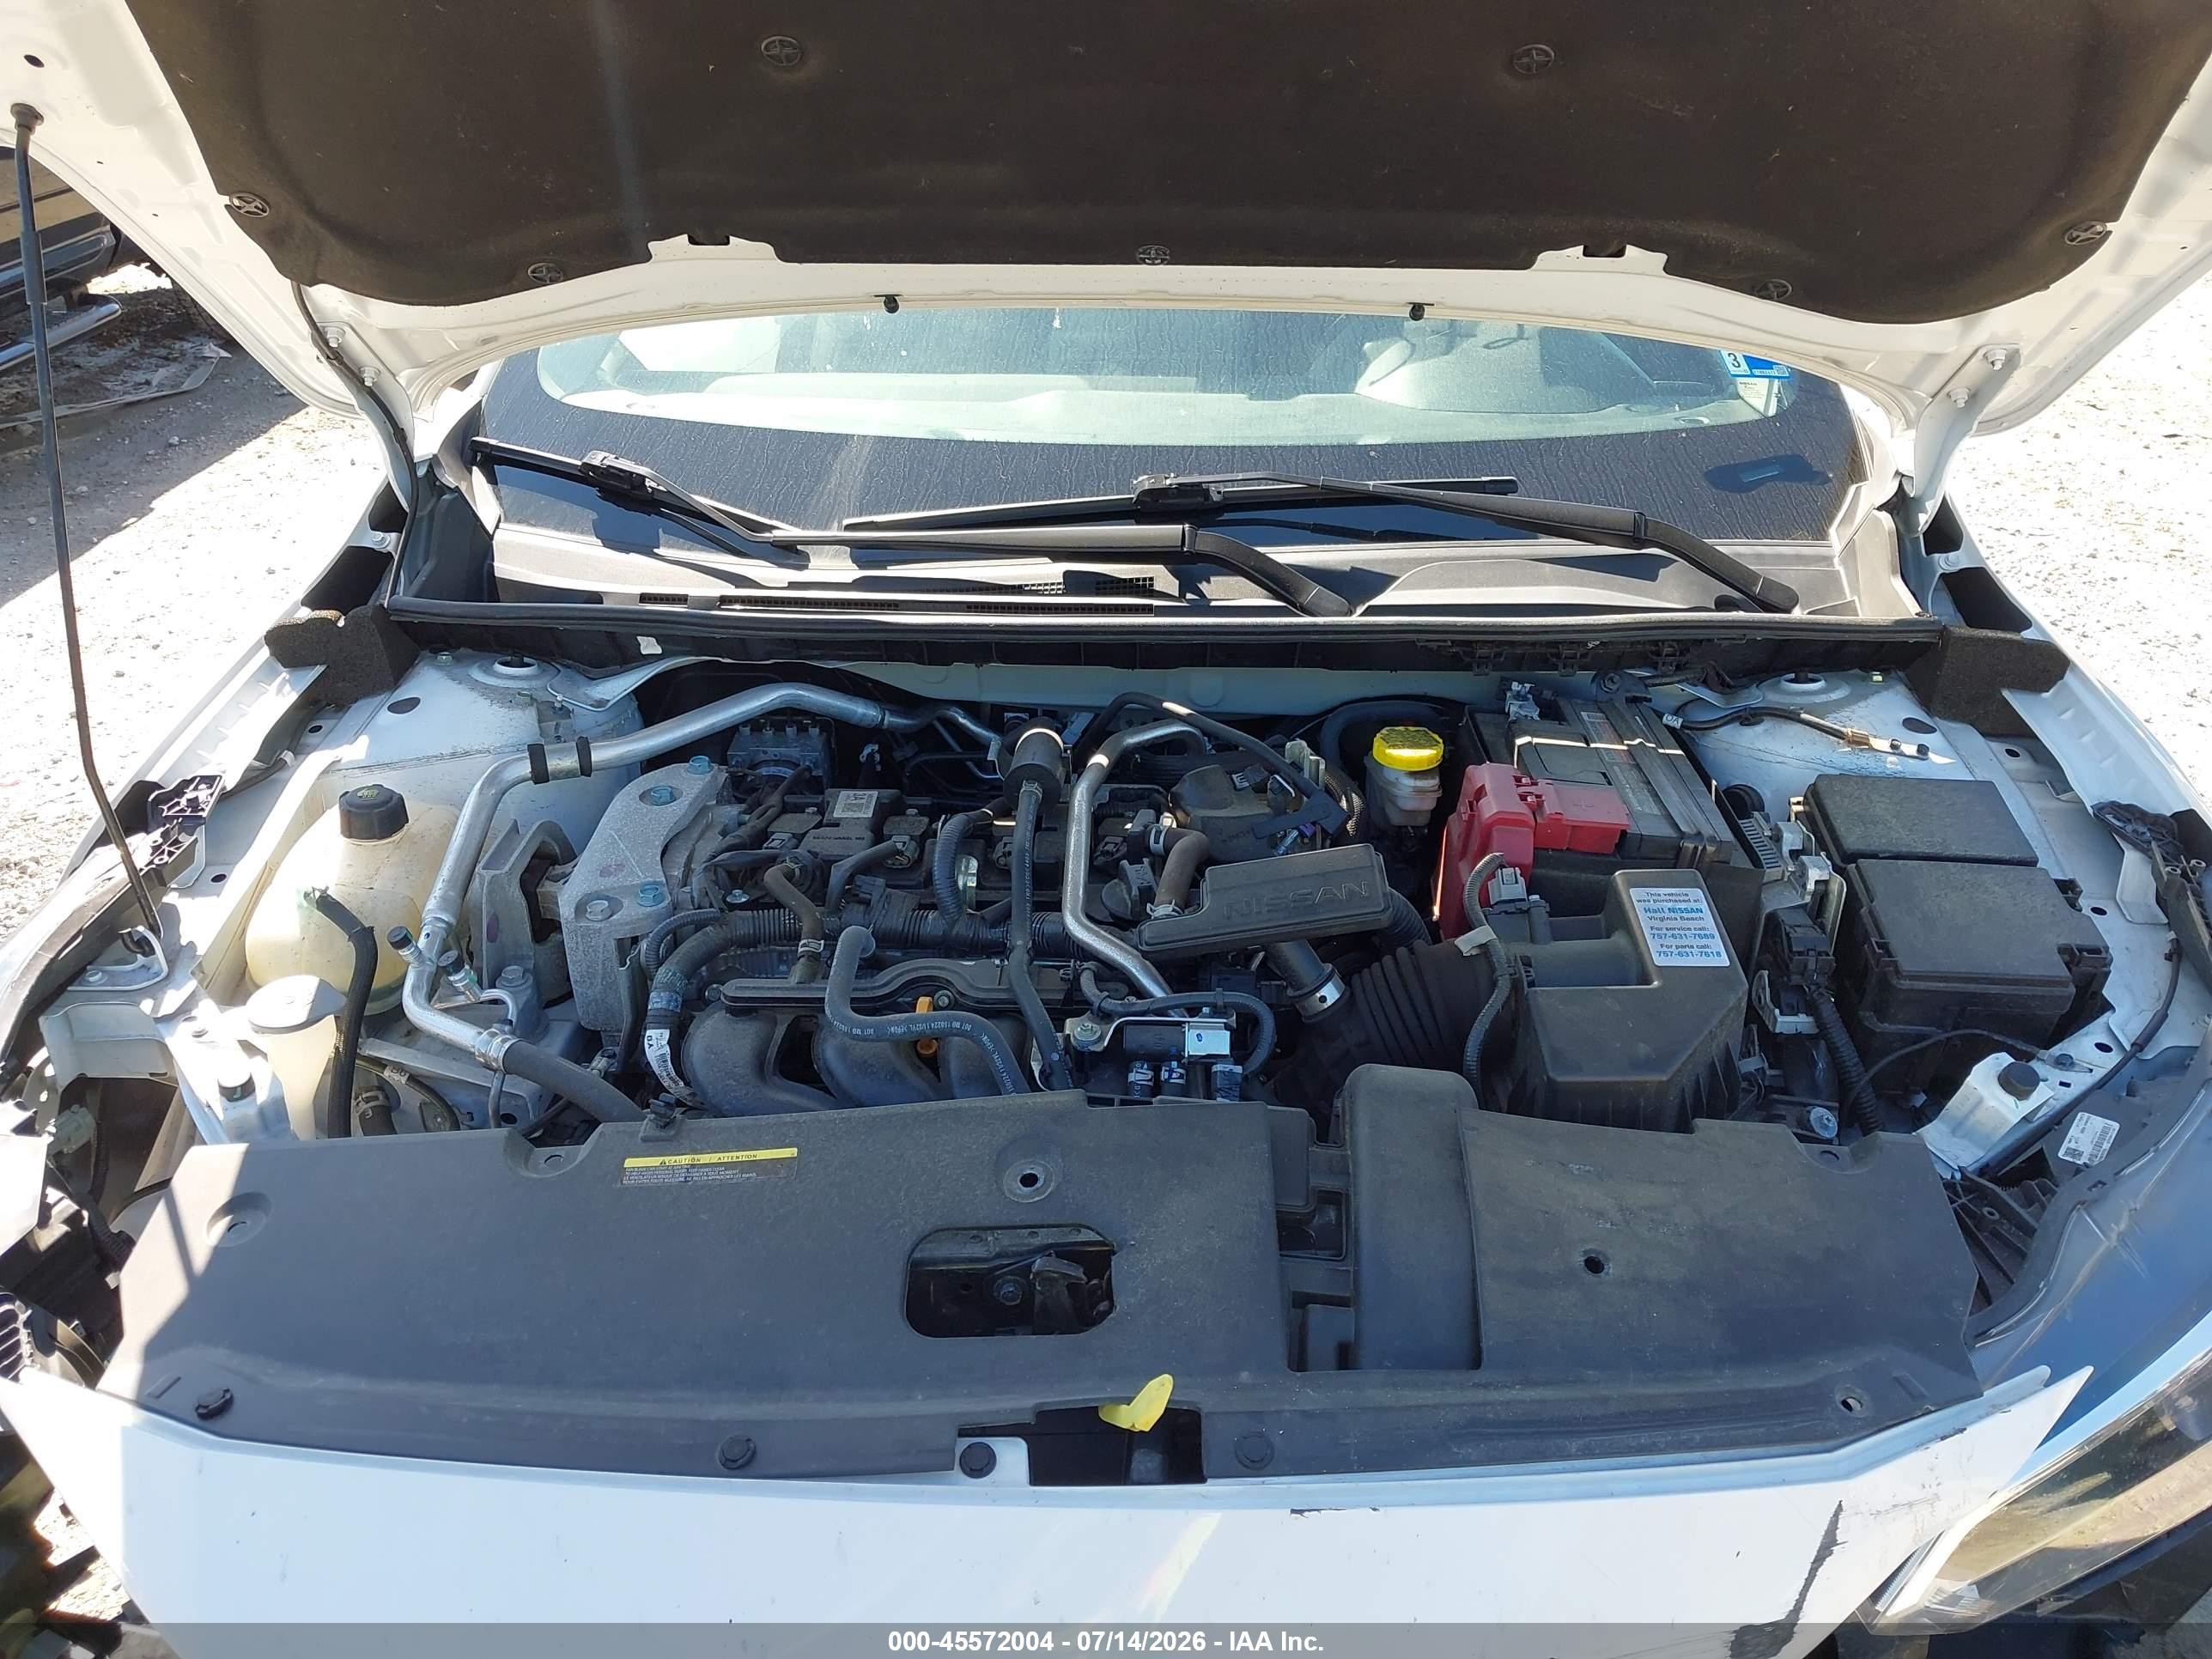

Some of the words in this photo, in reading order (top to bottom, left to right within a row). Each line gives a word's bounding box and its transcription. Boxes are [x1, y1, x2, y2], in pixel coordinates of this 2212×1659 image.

[1728, 353, 1741, 368] 3
[1223, 881, 1368, 920] NISSAN
[716, 1153, 758, 1162] ATTENTION
